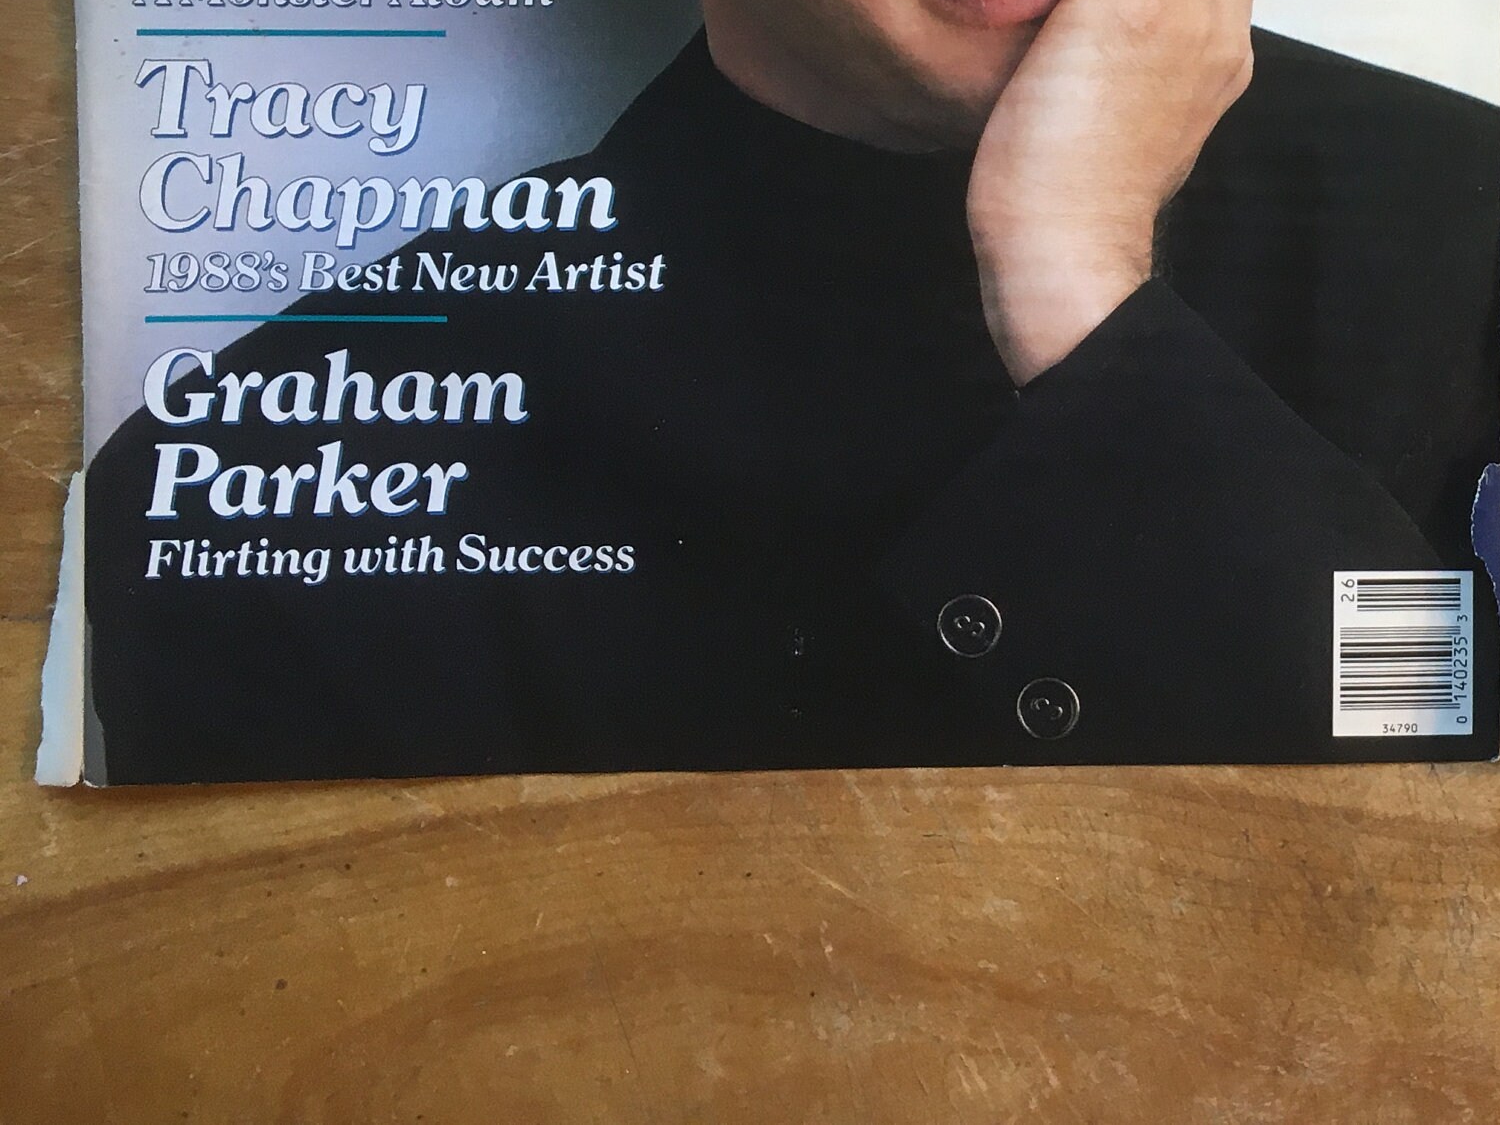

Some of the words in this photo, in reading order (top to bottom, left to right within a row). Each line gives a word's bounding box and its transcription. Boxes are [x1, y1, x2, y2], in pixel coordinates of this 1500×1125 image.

[134, 58, 426, 156] Tracy
[138, 151, 619, 249] Chapman
[144, 250, 289, 293] 1988's
[299, 251, 404, 293] Best
[411, 251, 519, 293] New
[524, 250, 667, 293] Artist
[142, 347, 530, 425] Graham
[145, 440, 469, 519] Parker
[144, 537, 331, 584] Flirting
[343, 534, 446, 574] with
[454, 534, 636, 574] Success
[1341, 578, 1356, 603] 26
[1453, 636, 1468, 702] 140235
[1382, 723, 1418, 734] 34790
